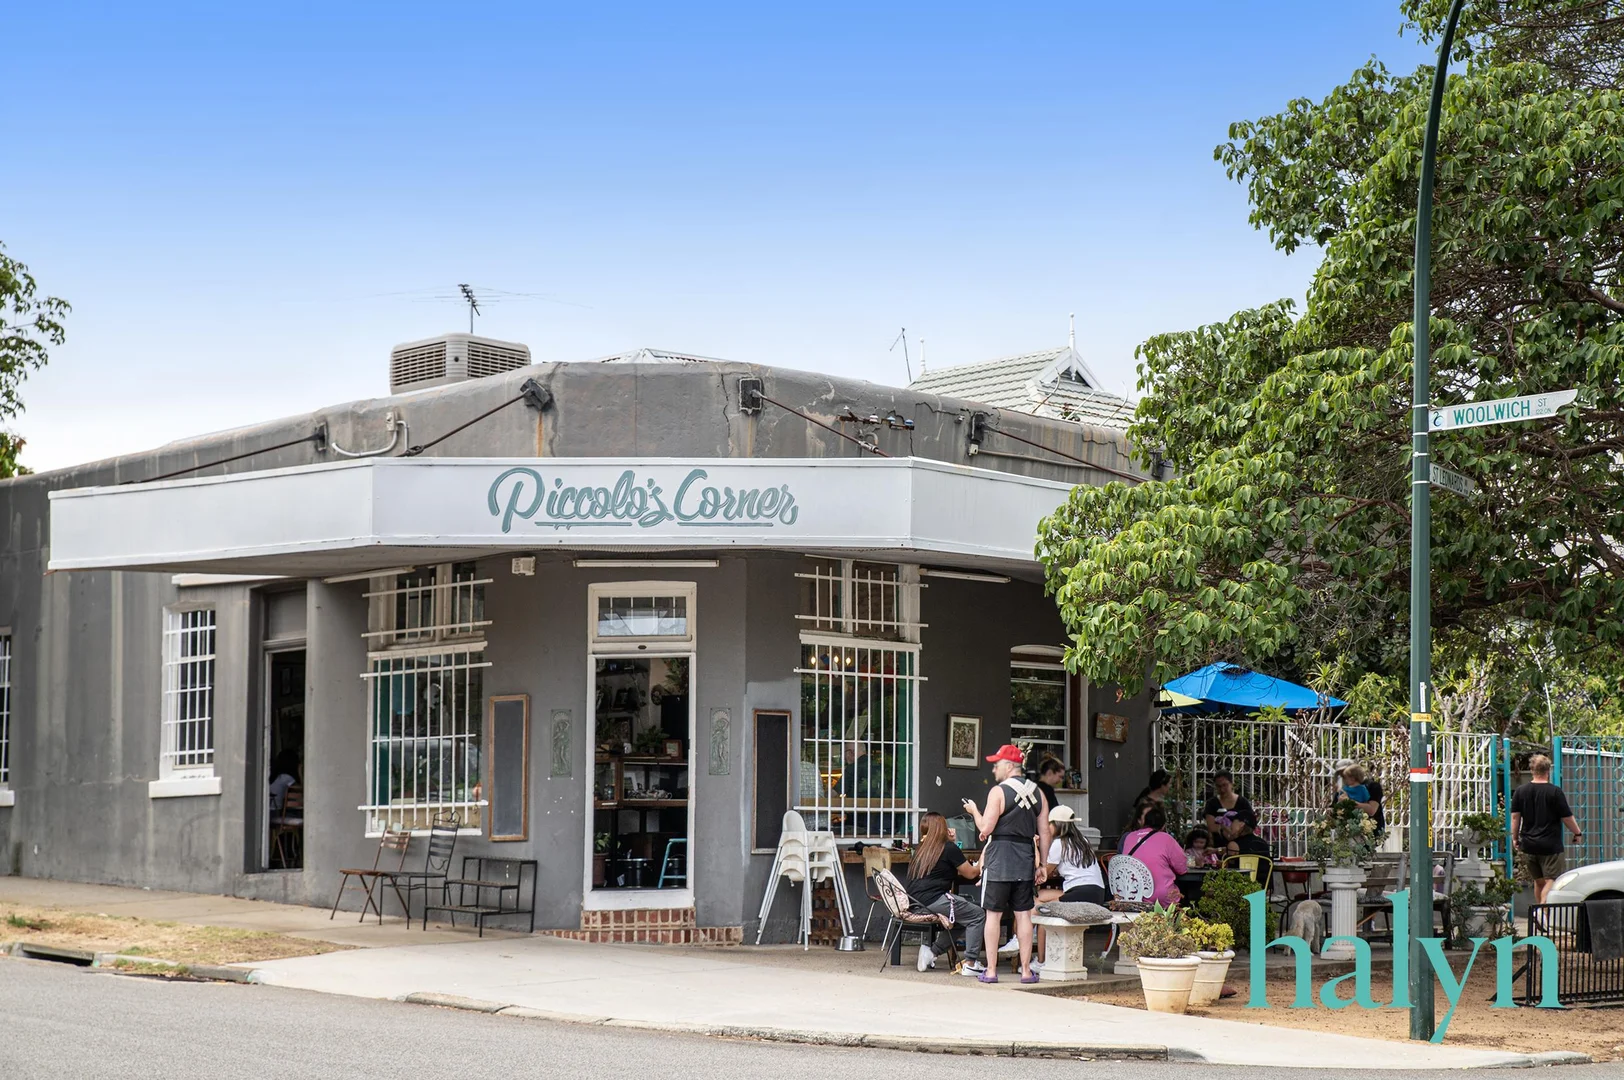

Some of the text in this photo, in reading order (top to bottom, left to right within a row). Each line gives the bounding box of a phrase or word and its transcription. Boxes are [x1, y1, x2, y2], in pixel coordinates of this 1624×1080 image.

[1453, 398, 1547, 426] WOOLWICH ST
[1432, 466, 1439, 483] ST
[488, 467, 799, 533] Piccolo's Corner
